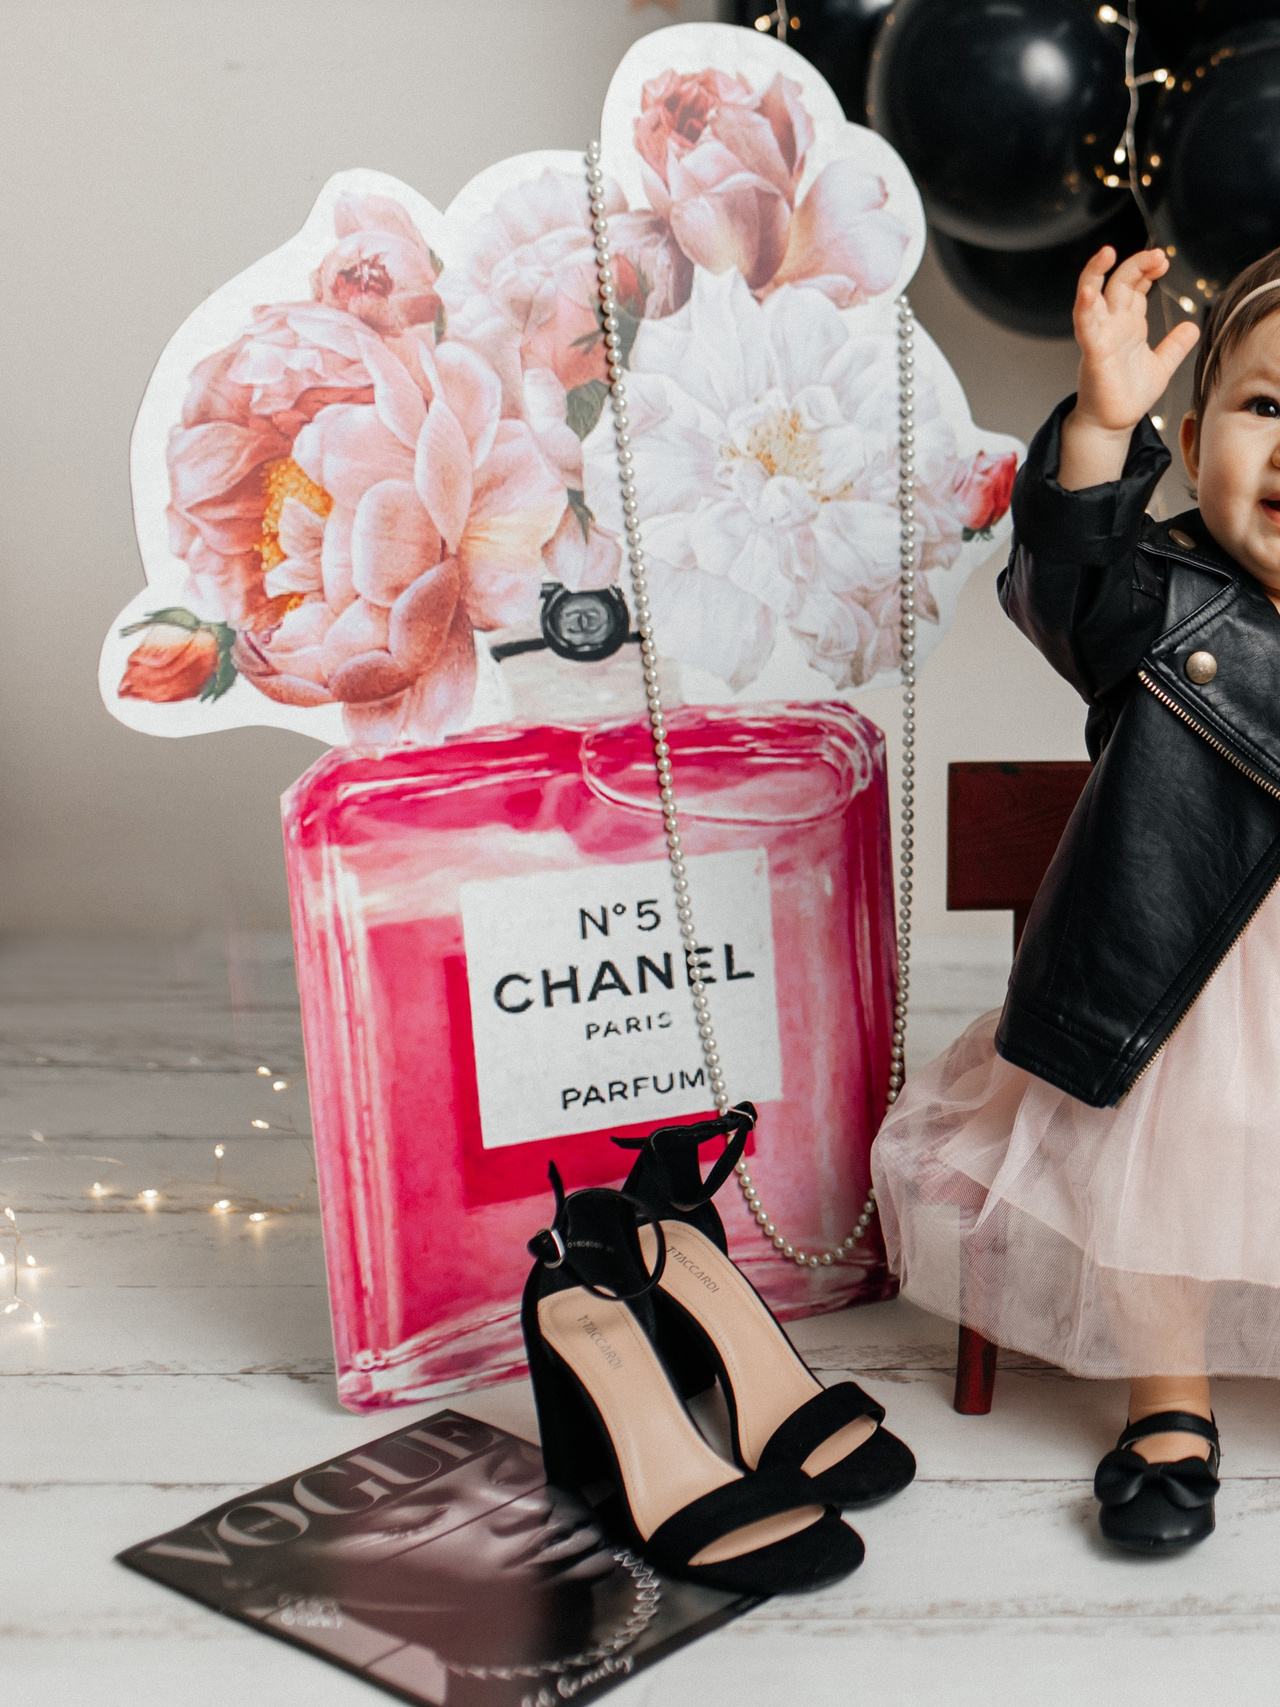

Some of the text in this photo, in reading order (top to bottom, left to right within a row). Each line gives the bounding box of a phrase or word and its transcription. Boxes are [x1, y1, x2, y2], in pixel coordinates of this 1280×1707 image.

[494, 944, 755, 1013] CHANEL
[586, 1012, 673, 1040] PARIS
[562, 1069, 705, 1110] PARFUM
[147, 1416, 505, 1566] VOGUE
